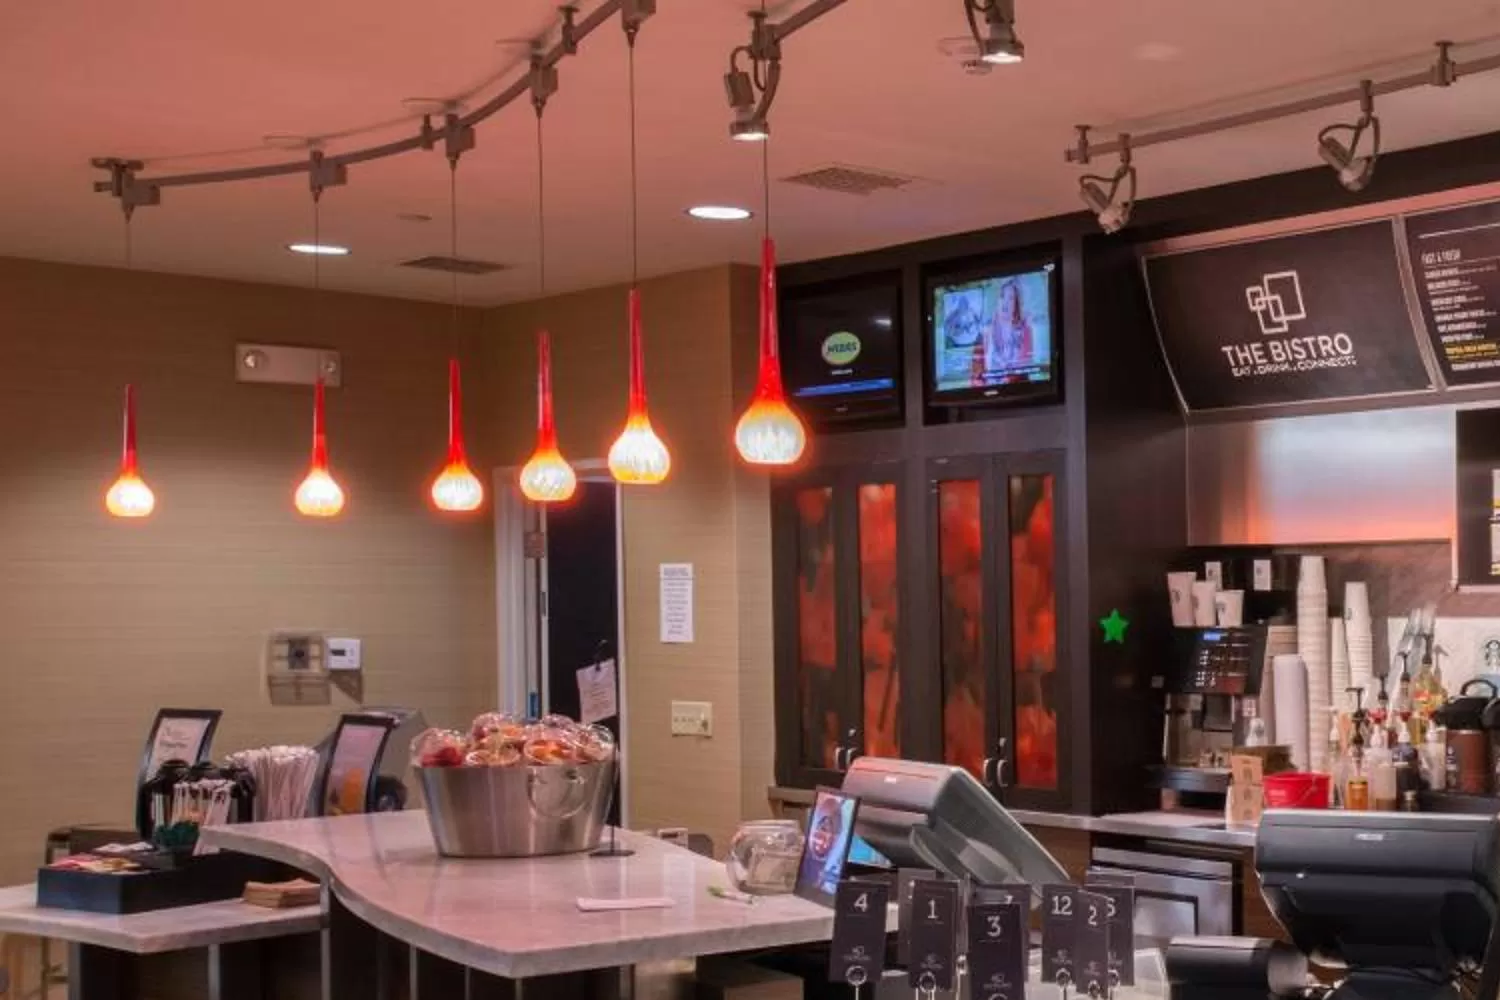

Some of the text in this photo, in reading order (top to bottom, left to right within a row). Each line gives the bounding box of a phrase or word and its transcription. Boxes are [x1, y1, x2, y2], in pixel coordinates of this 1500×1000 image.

[1220, 333, 1353, 367] THE BISTRO
[854, 893, 868, 912] 4
[928, 899, 939, 919] 1
[1051, 895, 1073, 915] 12
[1088, 904, 1097, 926] 2
[987, 915, 1001, 937] 3
